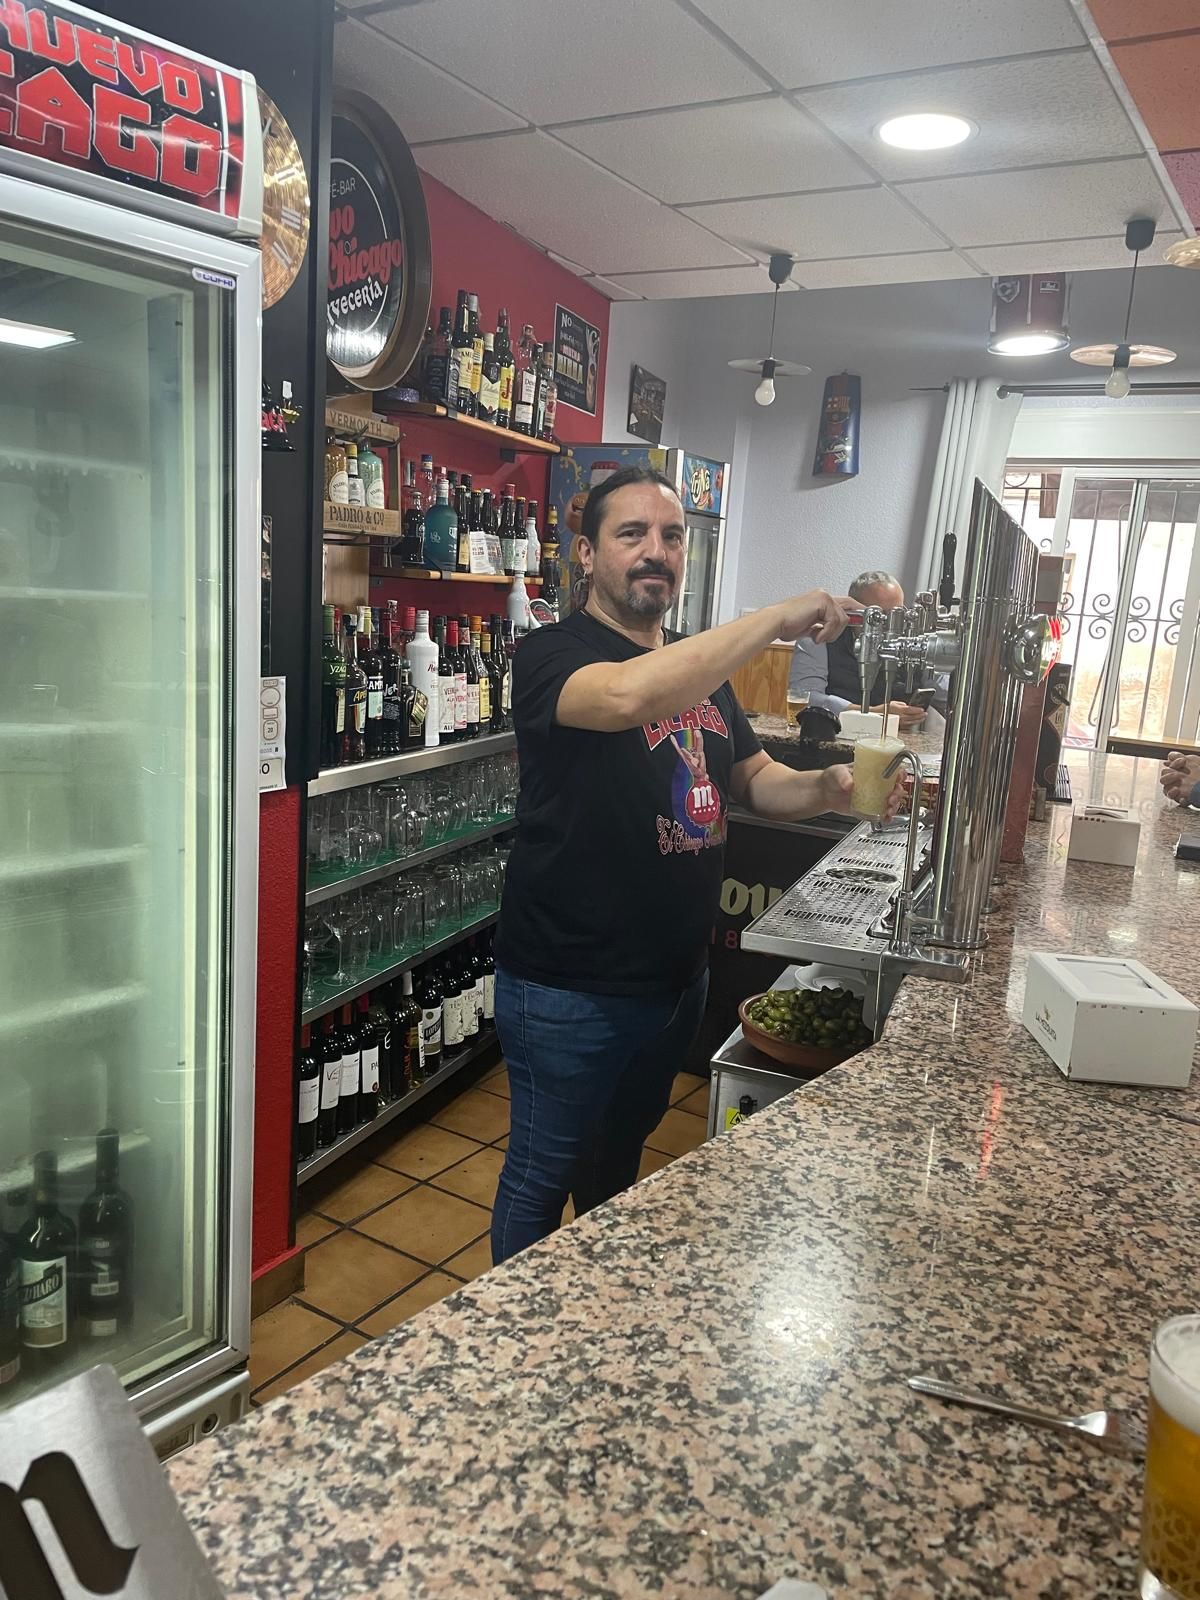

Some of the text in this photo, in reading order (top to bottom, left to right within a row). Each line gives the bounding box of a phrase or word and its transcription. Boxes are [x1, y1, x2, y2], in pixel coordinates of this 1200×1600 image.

[0, 51, 223, 198] AGO
[330, 411, 382, 436] VERMOUTH
[365, 510, 373, 524] &
